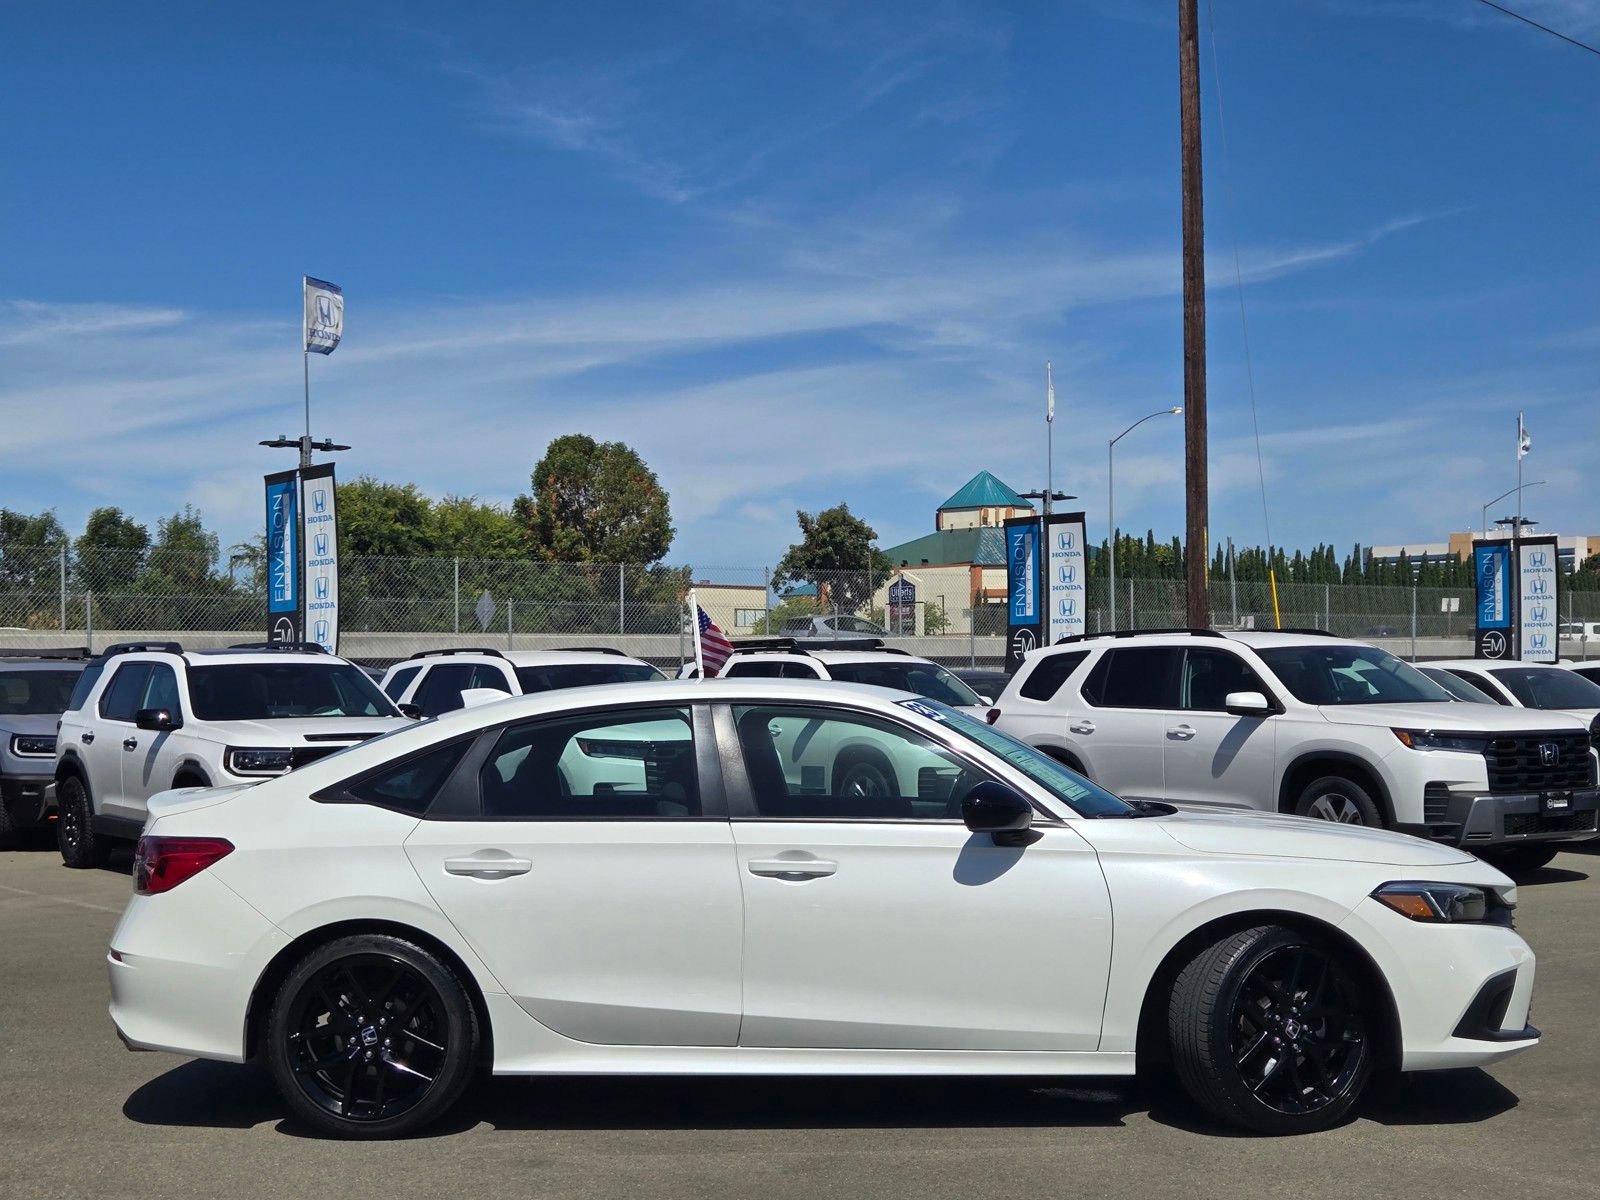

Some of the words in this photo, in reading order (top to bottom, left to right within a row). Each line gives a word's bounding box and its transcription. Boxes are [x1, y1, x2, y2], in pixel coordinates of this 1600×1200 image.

[307, 515, 334, 524] HONDA
[272, 494, 285, 602] ENVISION
[308, 557, 336, 567] HONDA
[1013, 533, 1026, 617] ENVISION
[1482, 553, 1495, 622] ENVISION
[308, 602, 336, 610] HONDA
